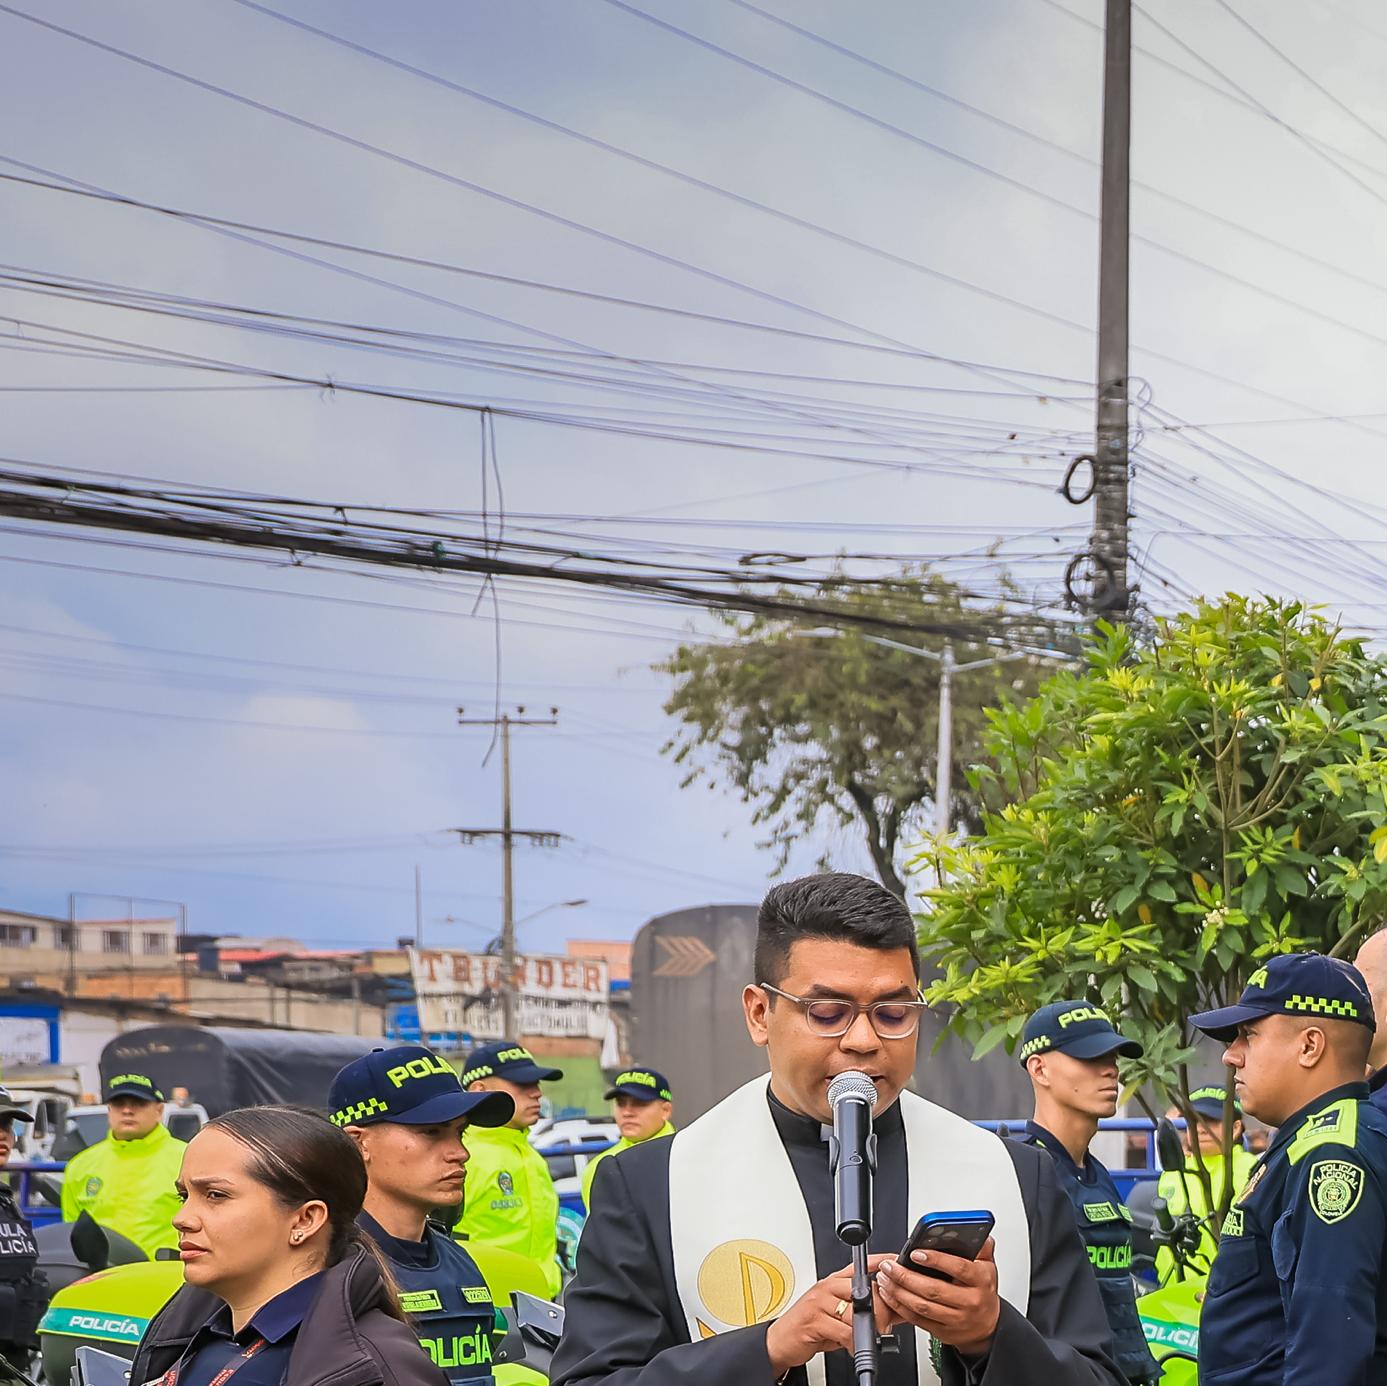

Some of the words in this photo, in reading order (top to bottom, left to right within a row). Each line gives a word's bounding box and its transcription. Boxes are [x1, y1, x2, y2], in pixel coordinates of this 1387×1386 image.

[1320, 1164, 1358, 1178] POLICÍA
[1313, 1172, 1359, 1190] NACIONAL
[68, 1315, 140, 1336] POLICÍA
